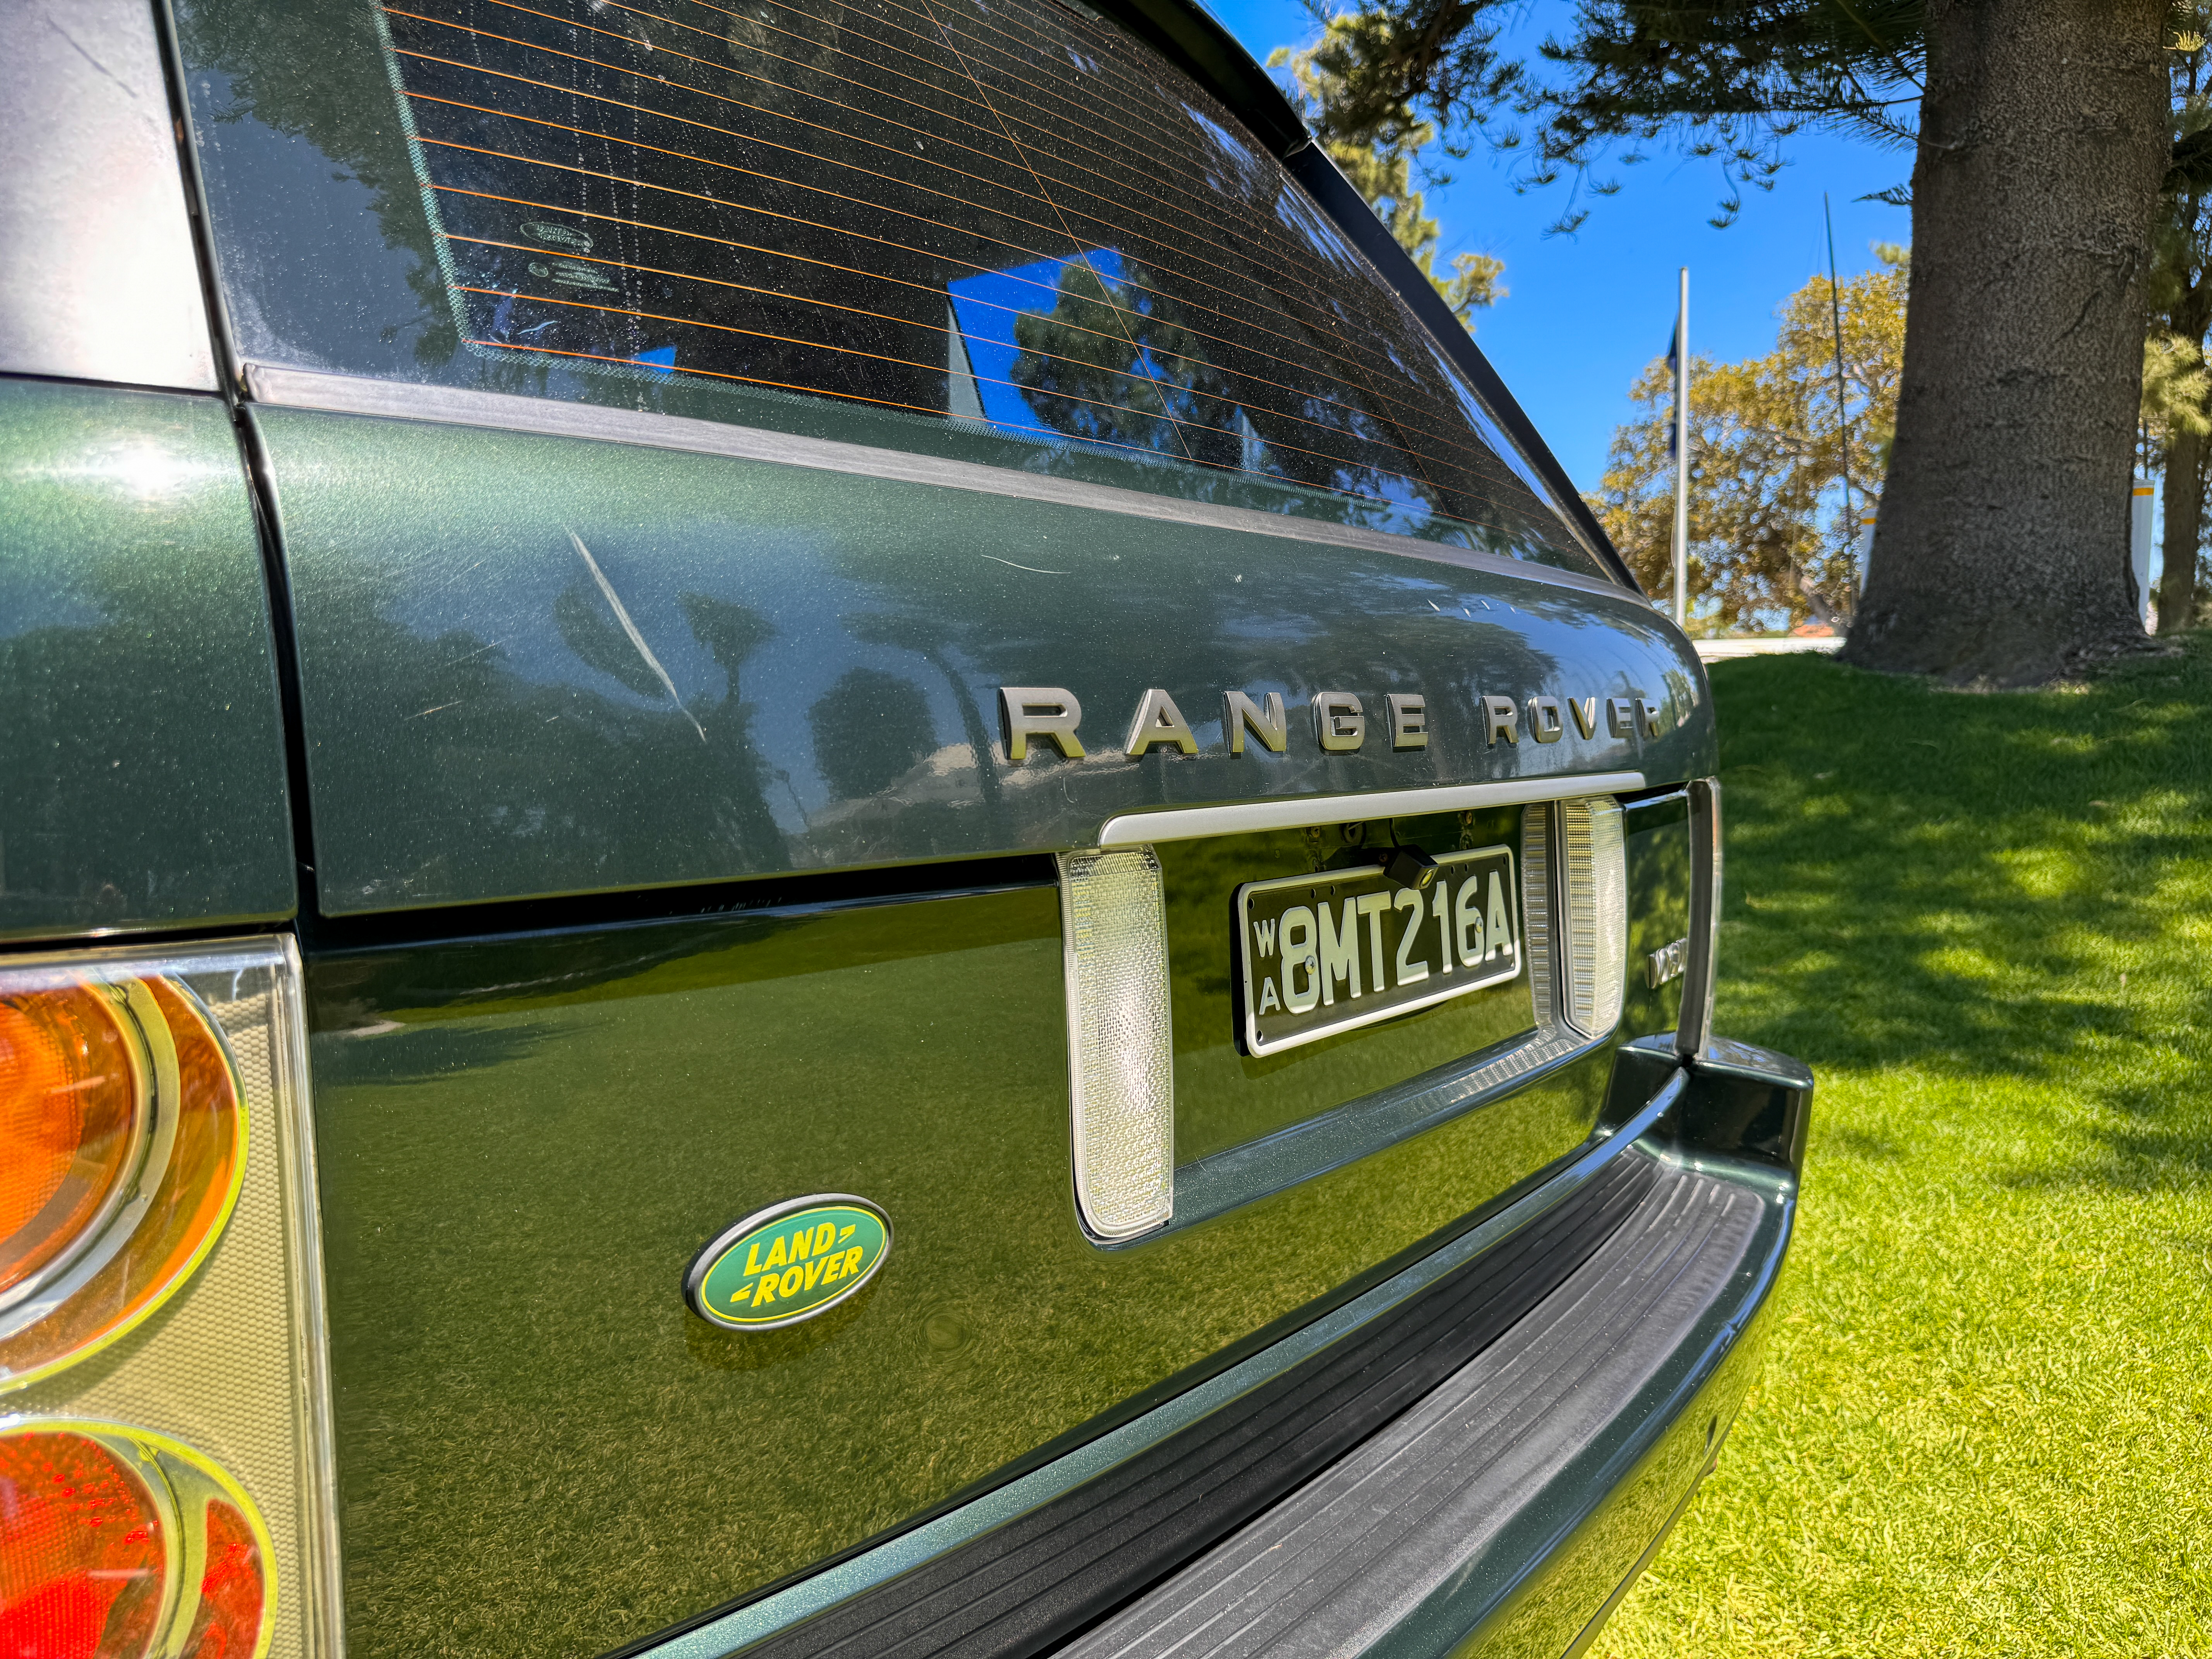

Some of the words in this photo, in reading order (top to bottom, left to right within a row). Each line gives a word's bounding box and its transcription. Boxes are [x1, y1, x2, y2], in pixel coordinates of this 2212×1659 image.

[1000, 687, 1428, 760] RANGE
[1480, 696, 1659, 745] ROVER
[1279, 871, 1513, 1014] 8MT216A
[743, 1222, 836, 1276] LAND
[750, 1245, 863, 1307] ROVER
